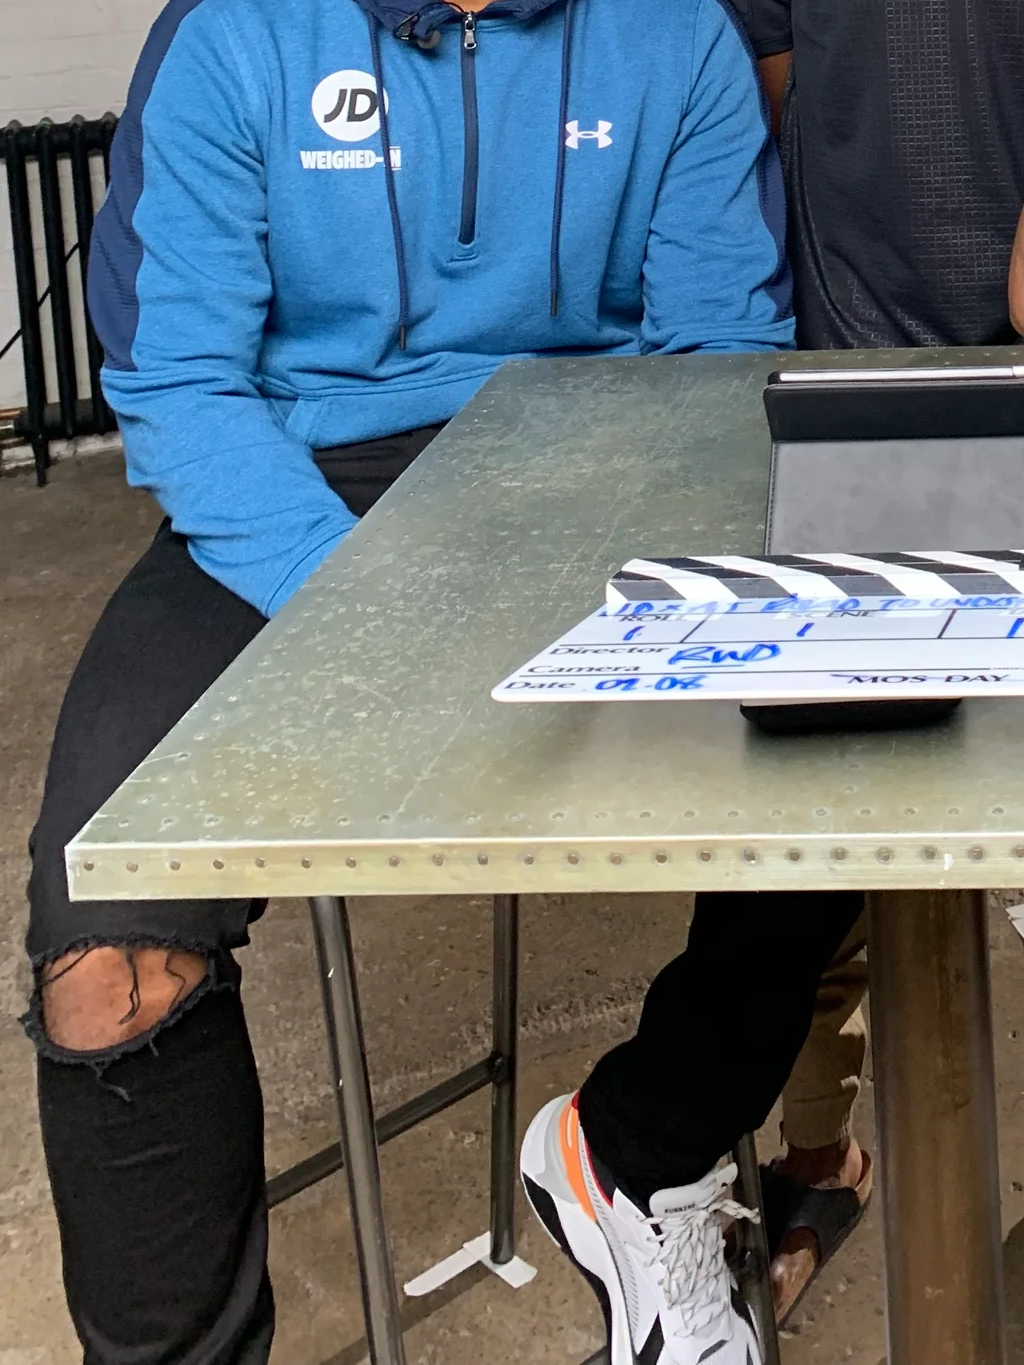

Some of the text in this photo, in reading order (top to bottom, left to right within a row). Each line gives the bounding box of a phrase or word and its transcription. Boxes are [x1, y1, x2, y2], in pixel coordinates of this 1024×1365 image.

[323, 87, 379, 124] JD
[300, 147, 402, 171] WEIGHED-N
[787, 609, 878, 619] SCENE
[549, 646, 670, 656] Director
[527, 665, 641, 674] Camera
[847, 674, 927, 684] MOS
[944, 674, 1010, 683] DAY
[504, 681, 576, 690] Date
